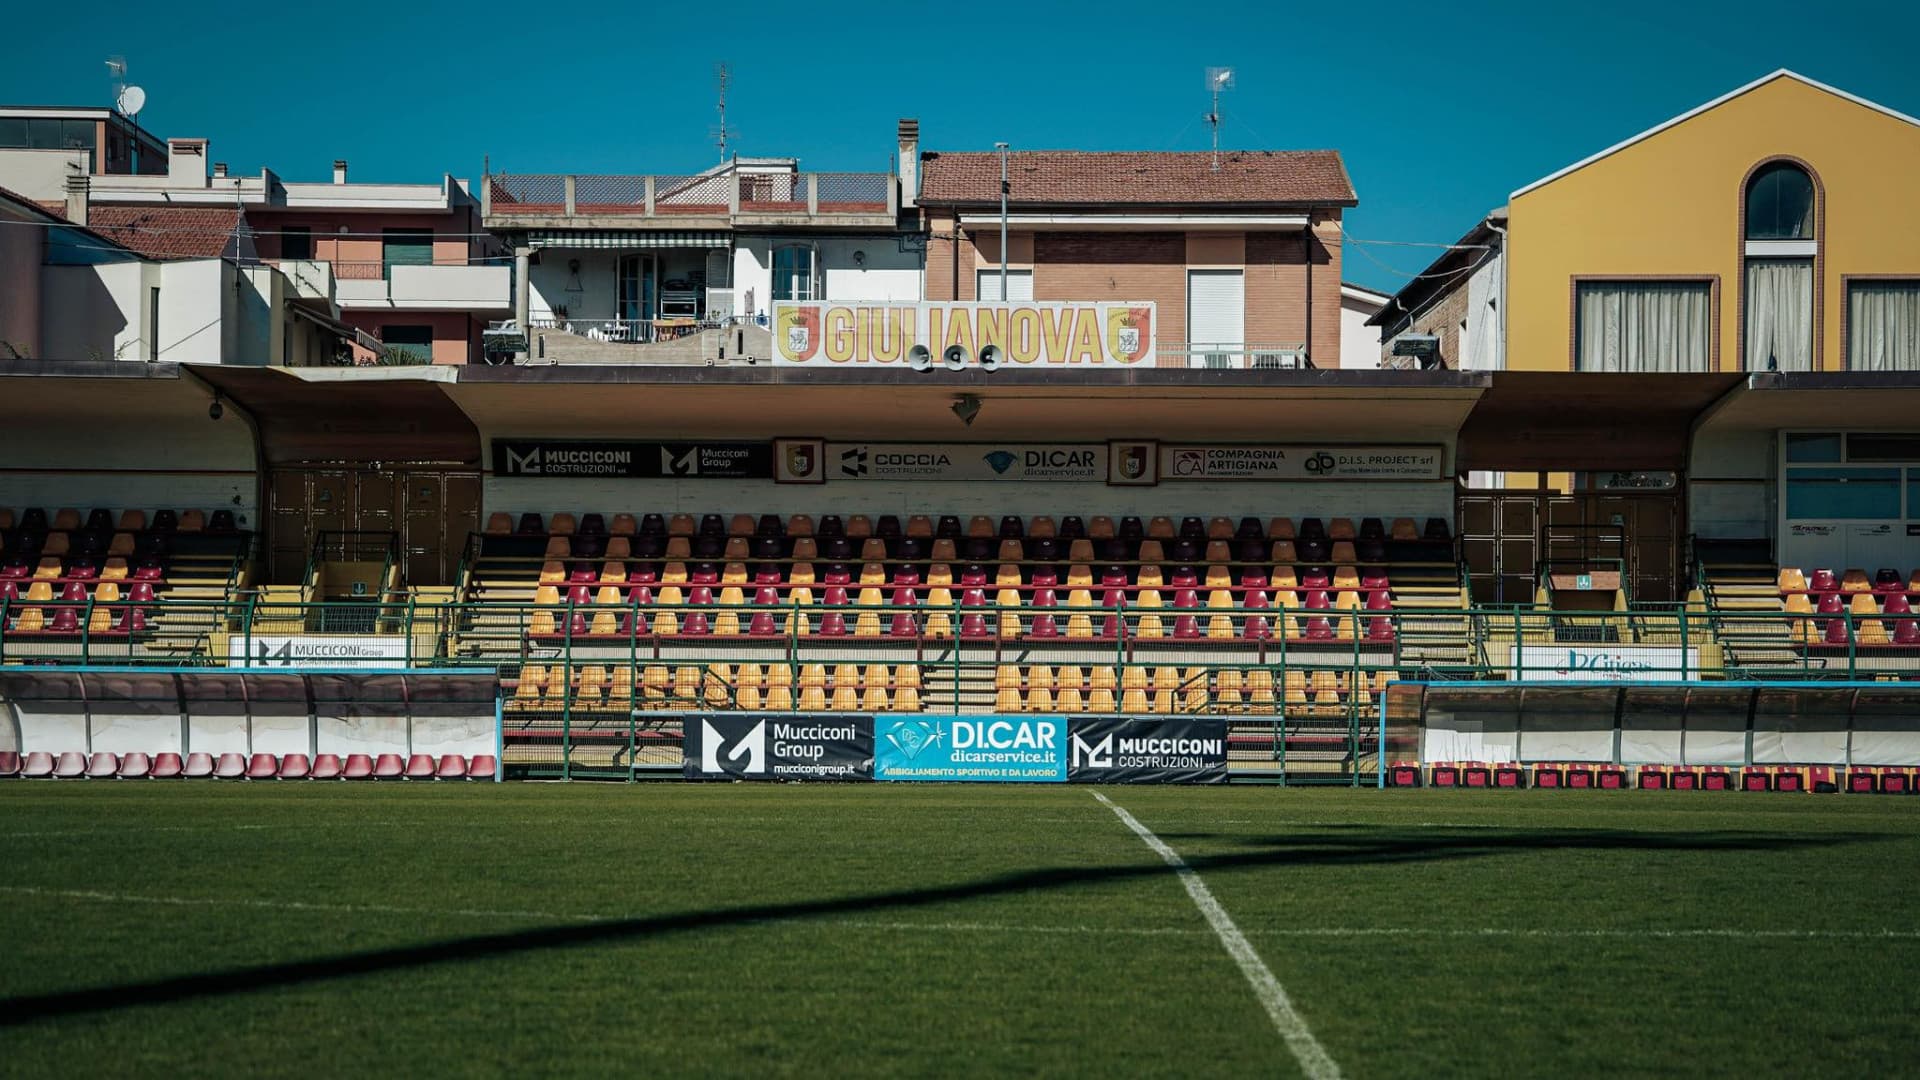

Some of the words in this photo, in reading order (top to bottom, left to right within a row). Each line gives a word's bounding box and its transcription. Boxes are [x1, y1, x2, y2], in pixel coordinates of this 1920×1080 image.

[825, 307, 1104, 363] GIULIANOVA
[545, 450, 631, 463] MUCCICONI
[702, 448, 749, 458] Mucciconi
[1025, 450, 1095, 467] DI.CAR
[1208, 450, 1286, 459] COMPAGNIA
[702, 458, 731, 468] Group
[875, 454, 951, 465] COCCIA
[1208, 460, 1278, 470] ARTIGIANA
[1339, 456, 1366, 465] D.I.S.
[1369, 456, 1418, 465] PROJECT
[1420, 456, 1434, 464] srl
[545, 464, 616, 473] COSTRUZIONI
[295, 645, 360, 656] MUCCICONI
[774, 723, 855, 740] Mucciconi
[951, 721, 1056, 749] DI.CAR
[774, 742, 824, 761] Group
[1119, 738, 1222, 755] MUCCICONI
[950, 749, 1056, 763] dicarservice.it
[1118, 756, 1203, 768] COSTRUZIONI
[774, 764, 855, 775] mucciconigroup.it
[884, 768, 955, 776] ABBIGLIAMENTO
[956, 768, 1000, 777] SPORTIVO
[1001, 768, 1007, 776] E
[1009, 768, 1021, 776] DA
[1022, 768, 1058, 777] LAVORO
